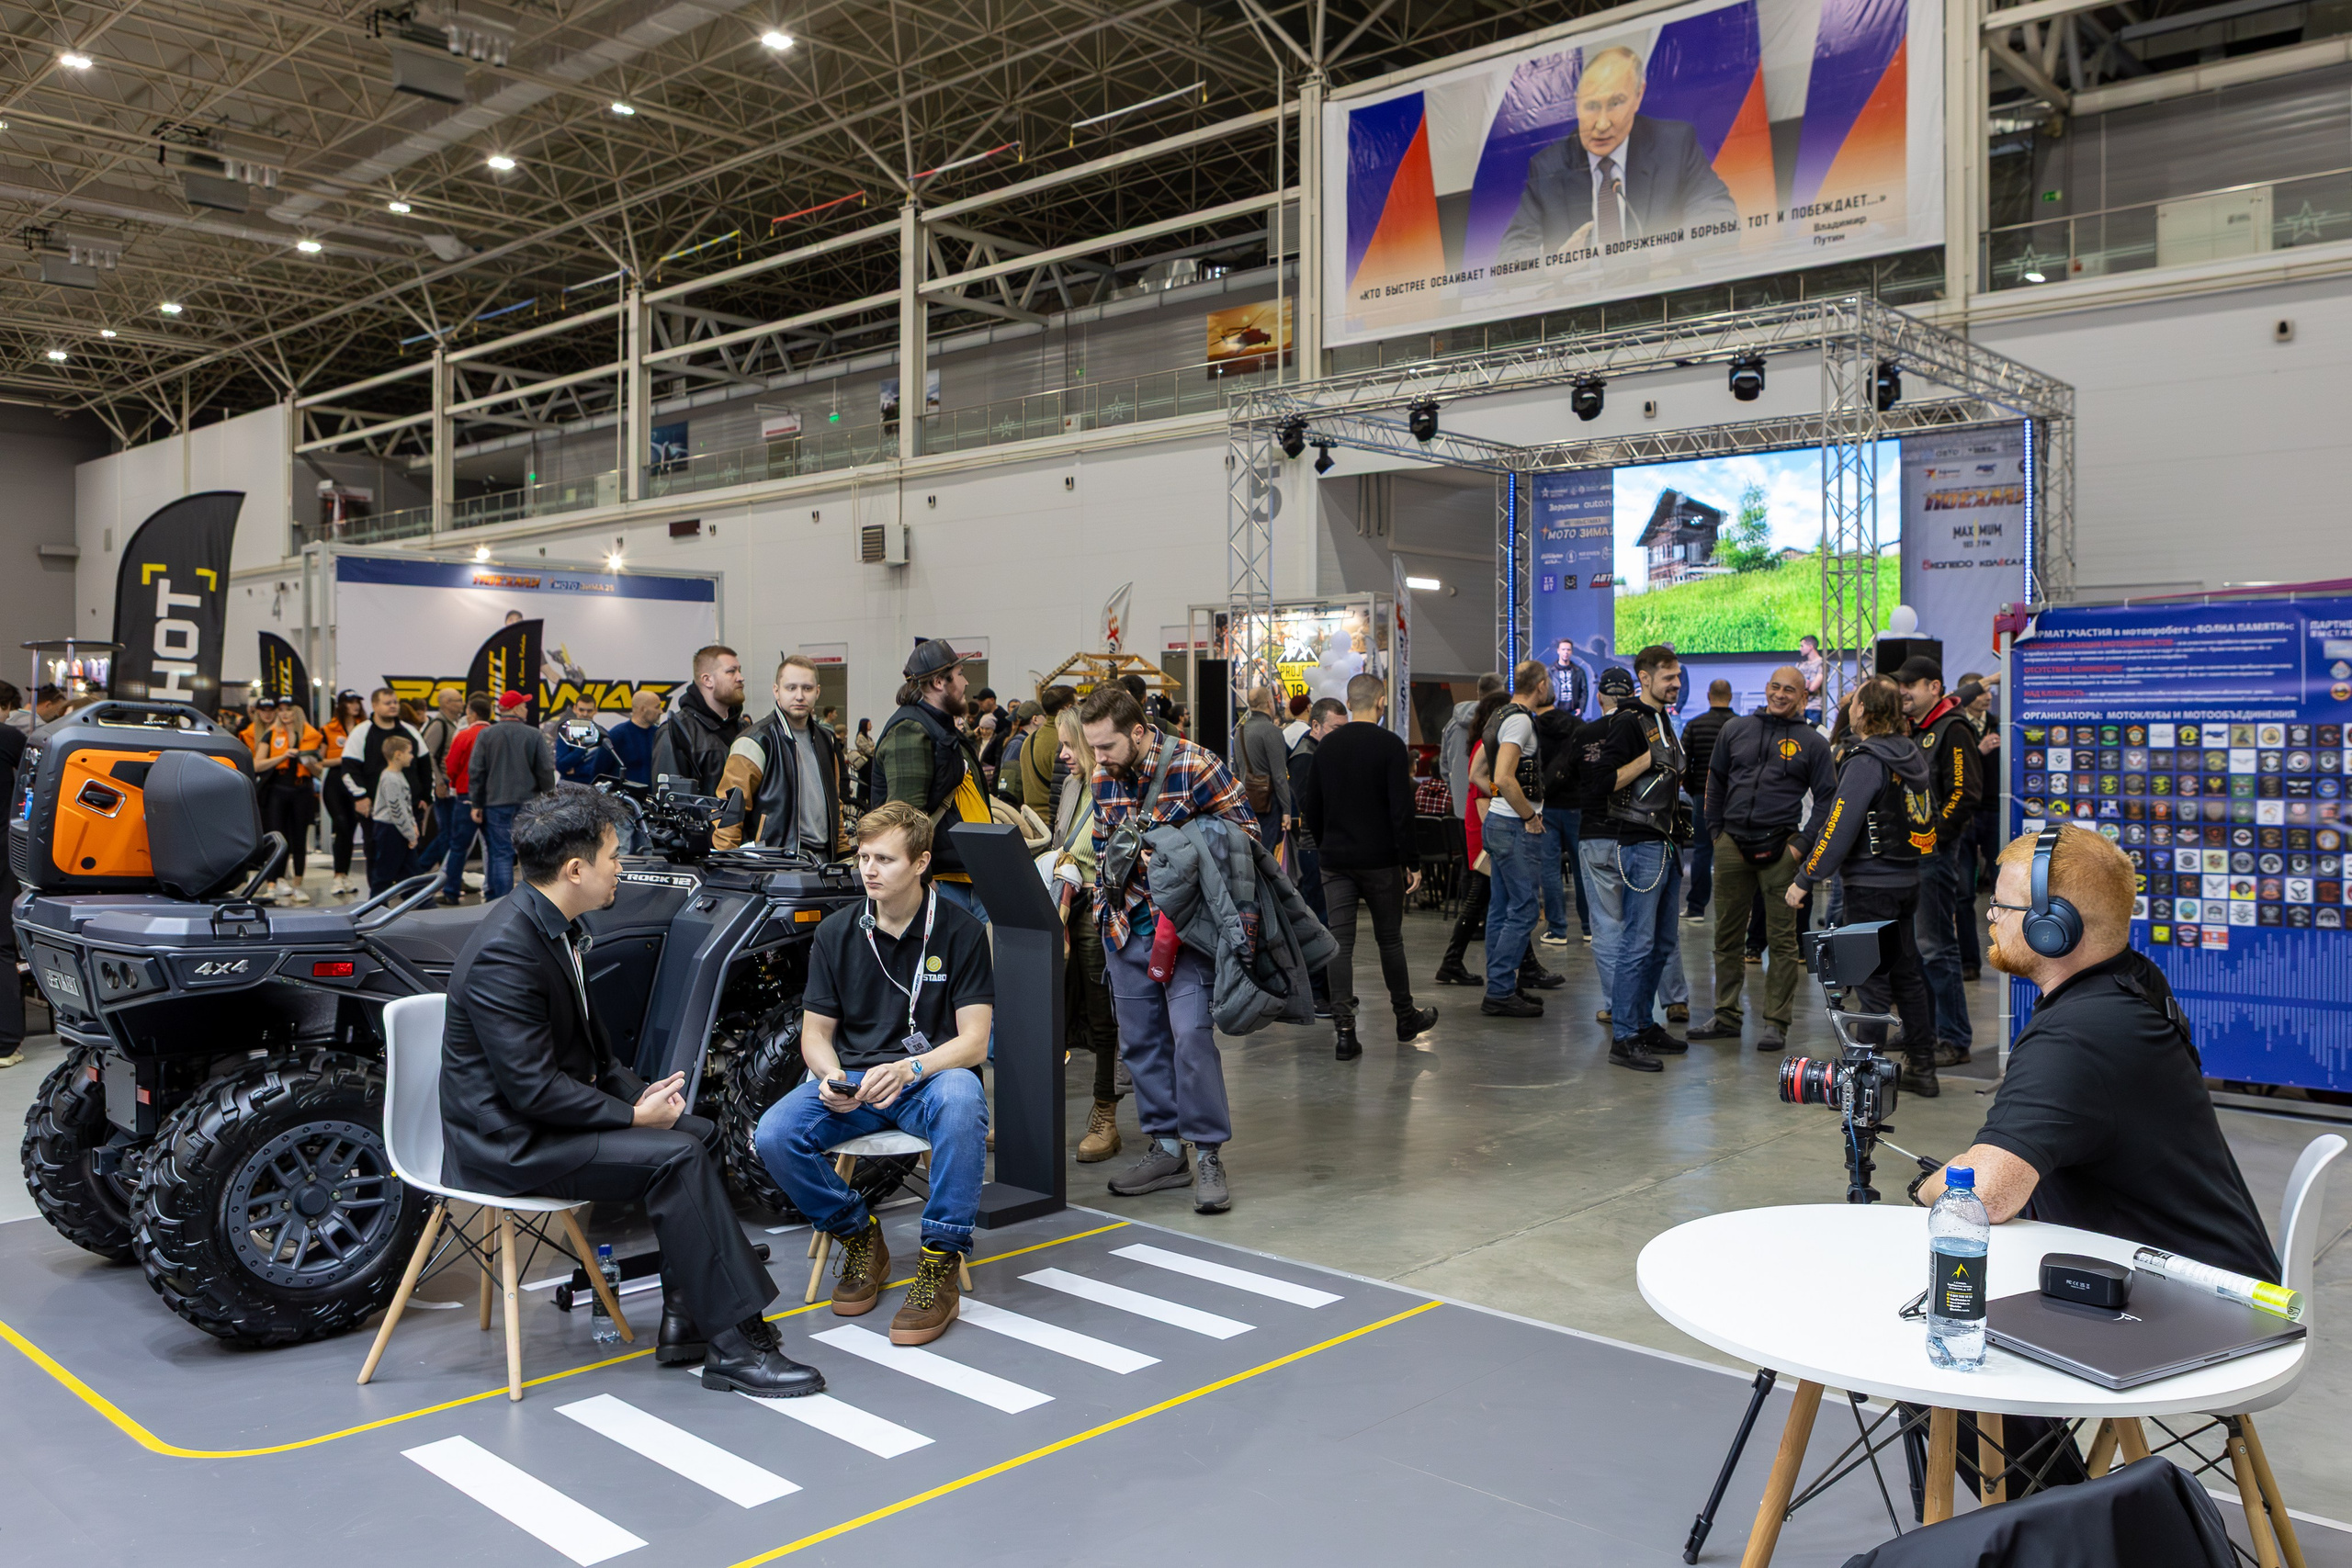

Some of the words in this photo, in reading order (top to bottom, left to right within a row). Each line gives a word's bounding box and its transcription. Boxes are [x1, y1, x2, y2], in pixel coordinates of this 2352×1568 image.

[1813, 232, 1846, 247] Путин
[1385, 279, 1425, 297] БЫСТРЕЕ
[1430, 268, 1485, 288] ОСВАИВАЕТ
[1489, 258, 1540, 277] НОВЕЙШИЕ
[1545, 247, 1599, 266] СРЕДСТВА
[1605, 229, 1684, 255] ВООРУЖЕННОЙ
[1747, 213, 1770, 229] ТОТ
[1777, 210, 1785, 224] И
[1547, 528, 1577, 540] МОТО
[553, 581, 579, 590] МОТО
[2033, 629, 2065, 638] ОРМАТ
[148, 579, 202, 729] HOT
[1280, 665, 1317, 677] PROJE
[1291, 683, 1304, 696] 18
[2023, 710, 2103, 721] ОРГАНИЗАТОРЫ:
[2106, 710, 2171, 721] МОТОКЛУБЫ
[2173, 710, 2182, 719] И
[627, 873, 670, 883] ROCK
[672, 876, 692, 886] 12
